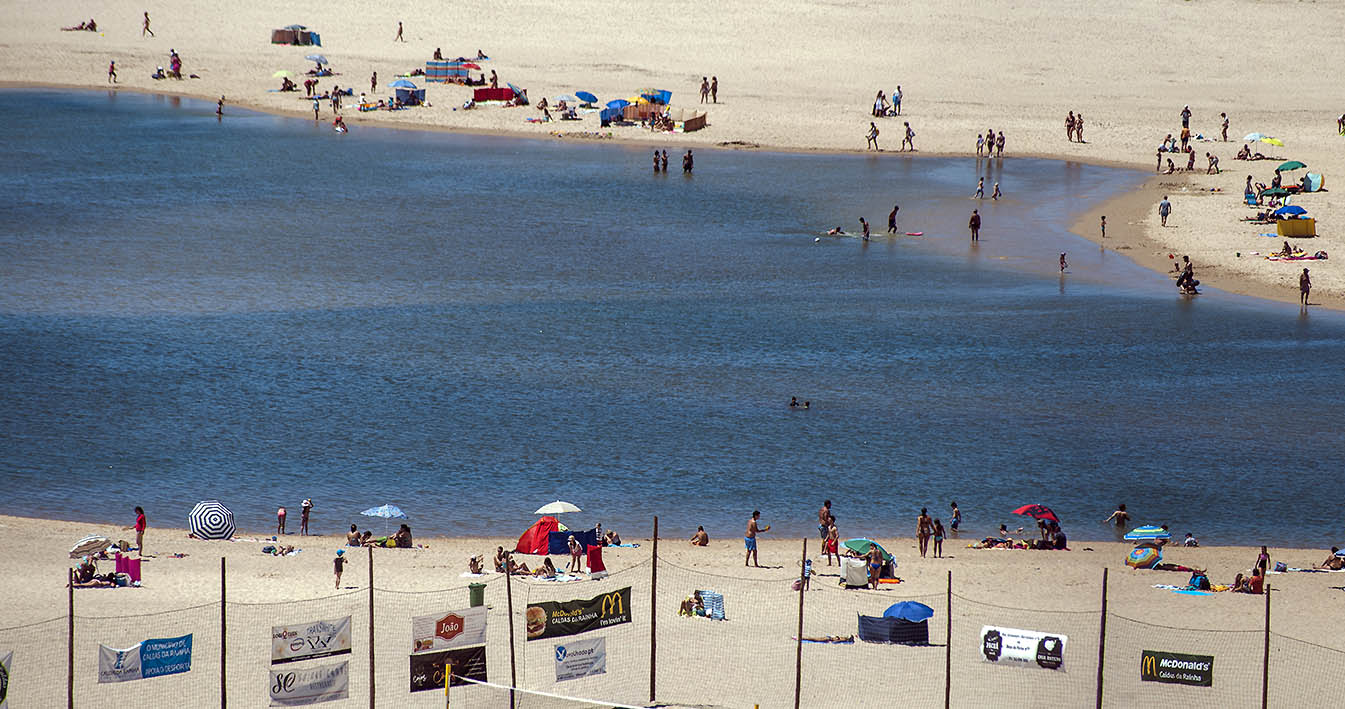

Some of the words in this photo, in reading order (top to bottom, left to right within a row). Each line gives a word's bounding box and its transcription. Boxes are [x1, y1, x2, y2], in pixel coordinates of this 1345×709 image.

[552, 616, 571, 625] CALDAS
[579, 612, 599, 622] RAINHA
[440, 622, 459, 634] João
[143, 651, 160, 661] CALDAS
[1160, 658, 1209, 671] McDonald's
[1183, 673, 1202, 682] Rainha
